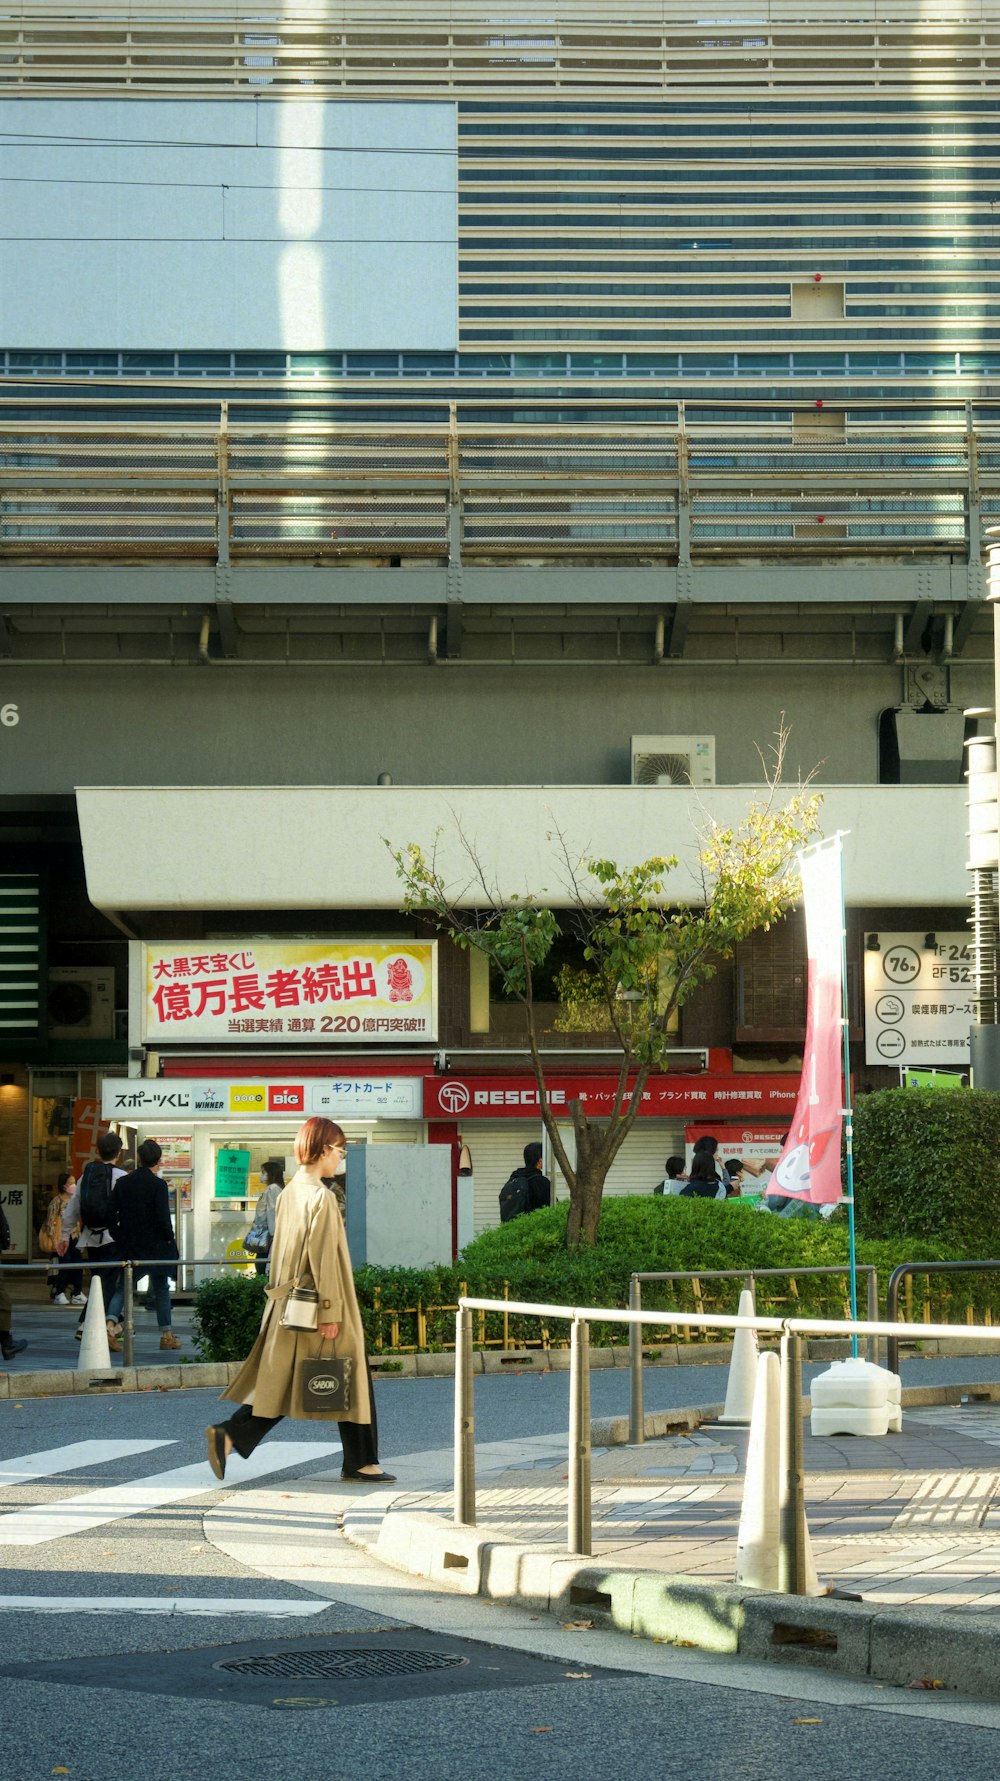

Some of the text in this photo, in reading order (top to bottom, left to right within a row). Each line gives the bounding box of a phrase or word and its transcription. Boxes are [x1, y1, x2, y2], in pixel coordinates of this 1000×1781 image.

[0, 703, 20, 727] 6
[152, 951, 256, 980] 大黒天宝くじ
[932, 966, 977, 983] 2F 52
[152, 960, 378, 1023] 億万長者続出
[228, 1018, 284, 1033] 当選実績
[287, 1018, 316, 1033] 通算
[332, 1082, 393, 1093] ギフトカード
[115, 1090, 190, 1108] スポーツくじ
[233, 1094, 263, 1102] toto
[659, 1091, 707, 1100] ブランド買取
[714, 1091, 763, 1100] 時計修理買取
[769, 1091, 796, 1099] iPhone
[195, 1101, 225, 1109] WINNER
[312, 1380, 335, 1389] SABON
